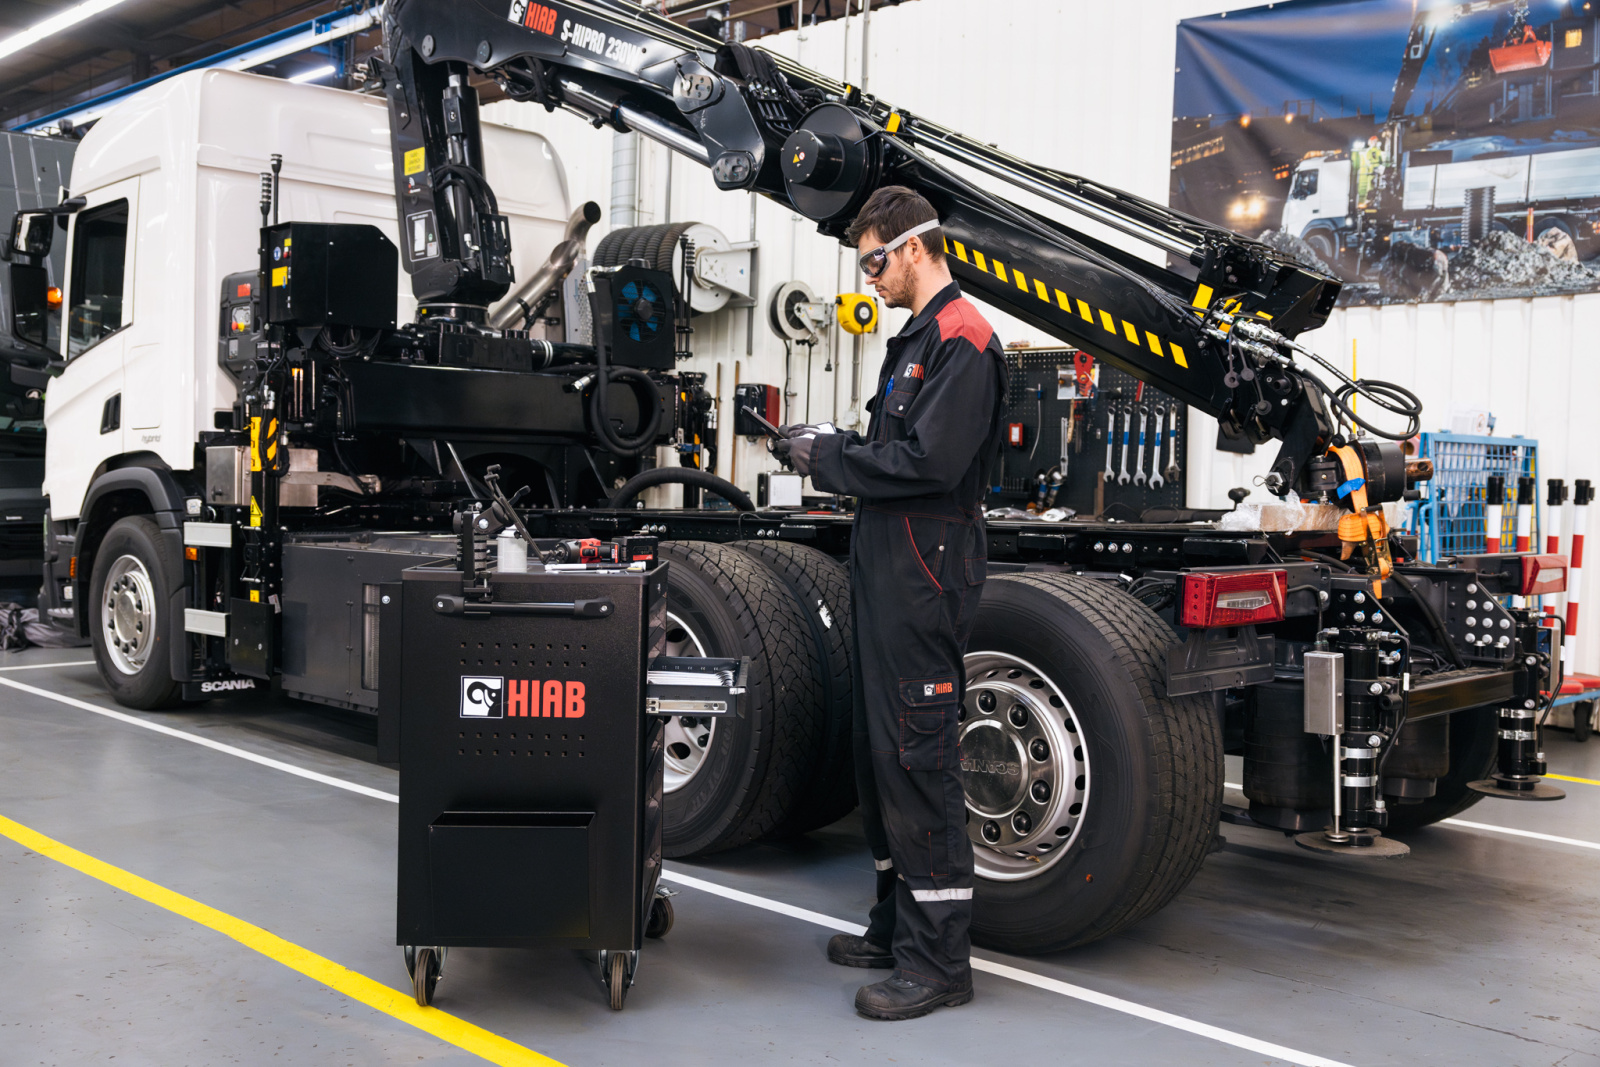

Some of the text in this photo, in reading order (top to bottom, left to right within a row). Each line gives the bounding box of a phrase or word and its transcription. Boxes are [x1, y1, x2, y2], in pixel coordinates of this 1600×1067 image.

[525, 1, 558, 36] HIAB
[561, 19, 606, 55] S-HIPRO
[911, 363, 925, 380] HIA
[201, 679, 256, 692] SCANIA
[508, 679, 586, 718] HIAB
[935, 682, 953, 694] HIAB
